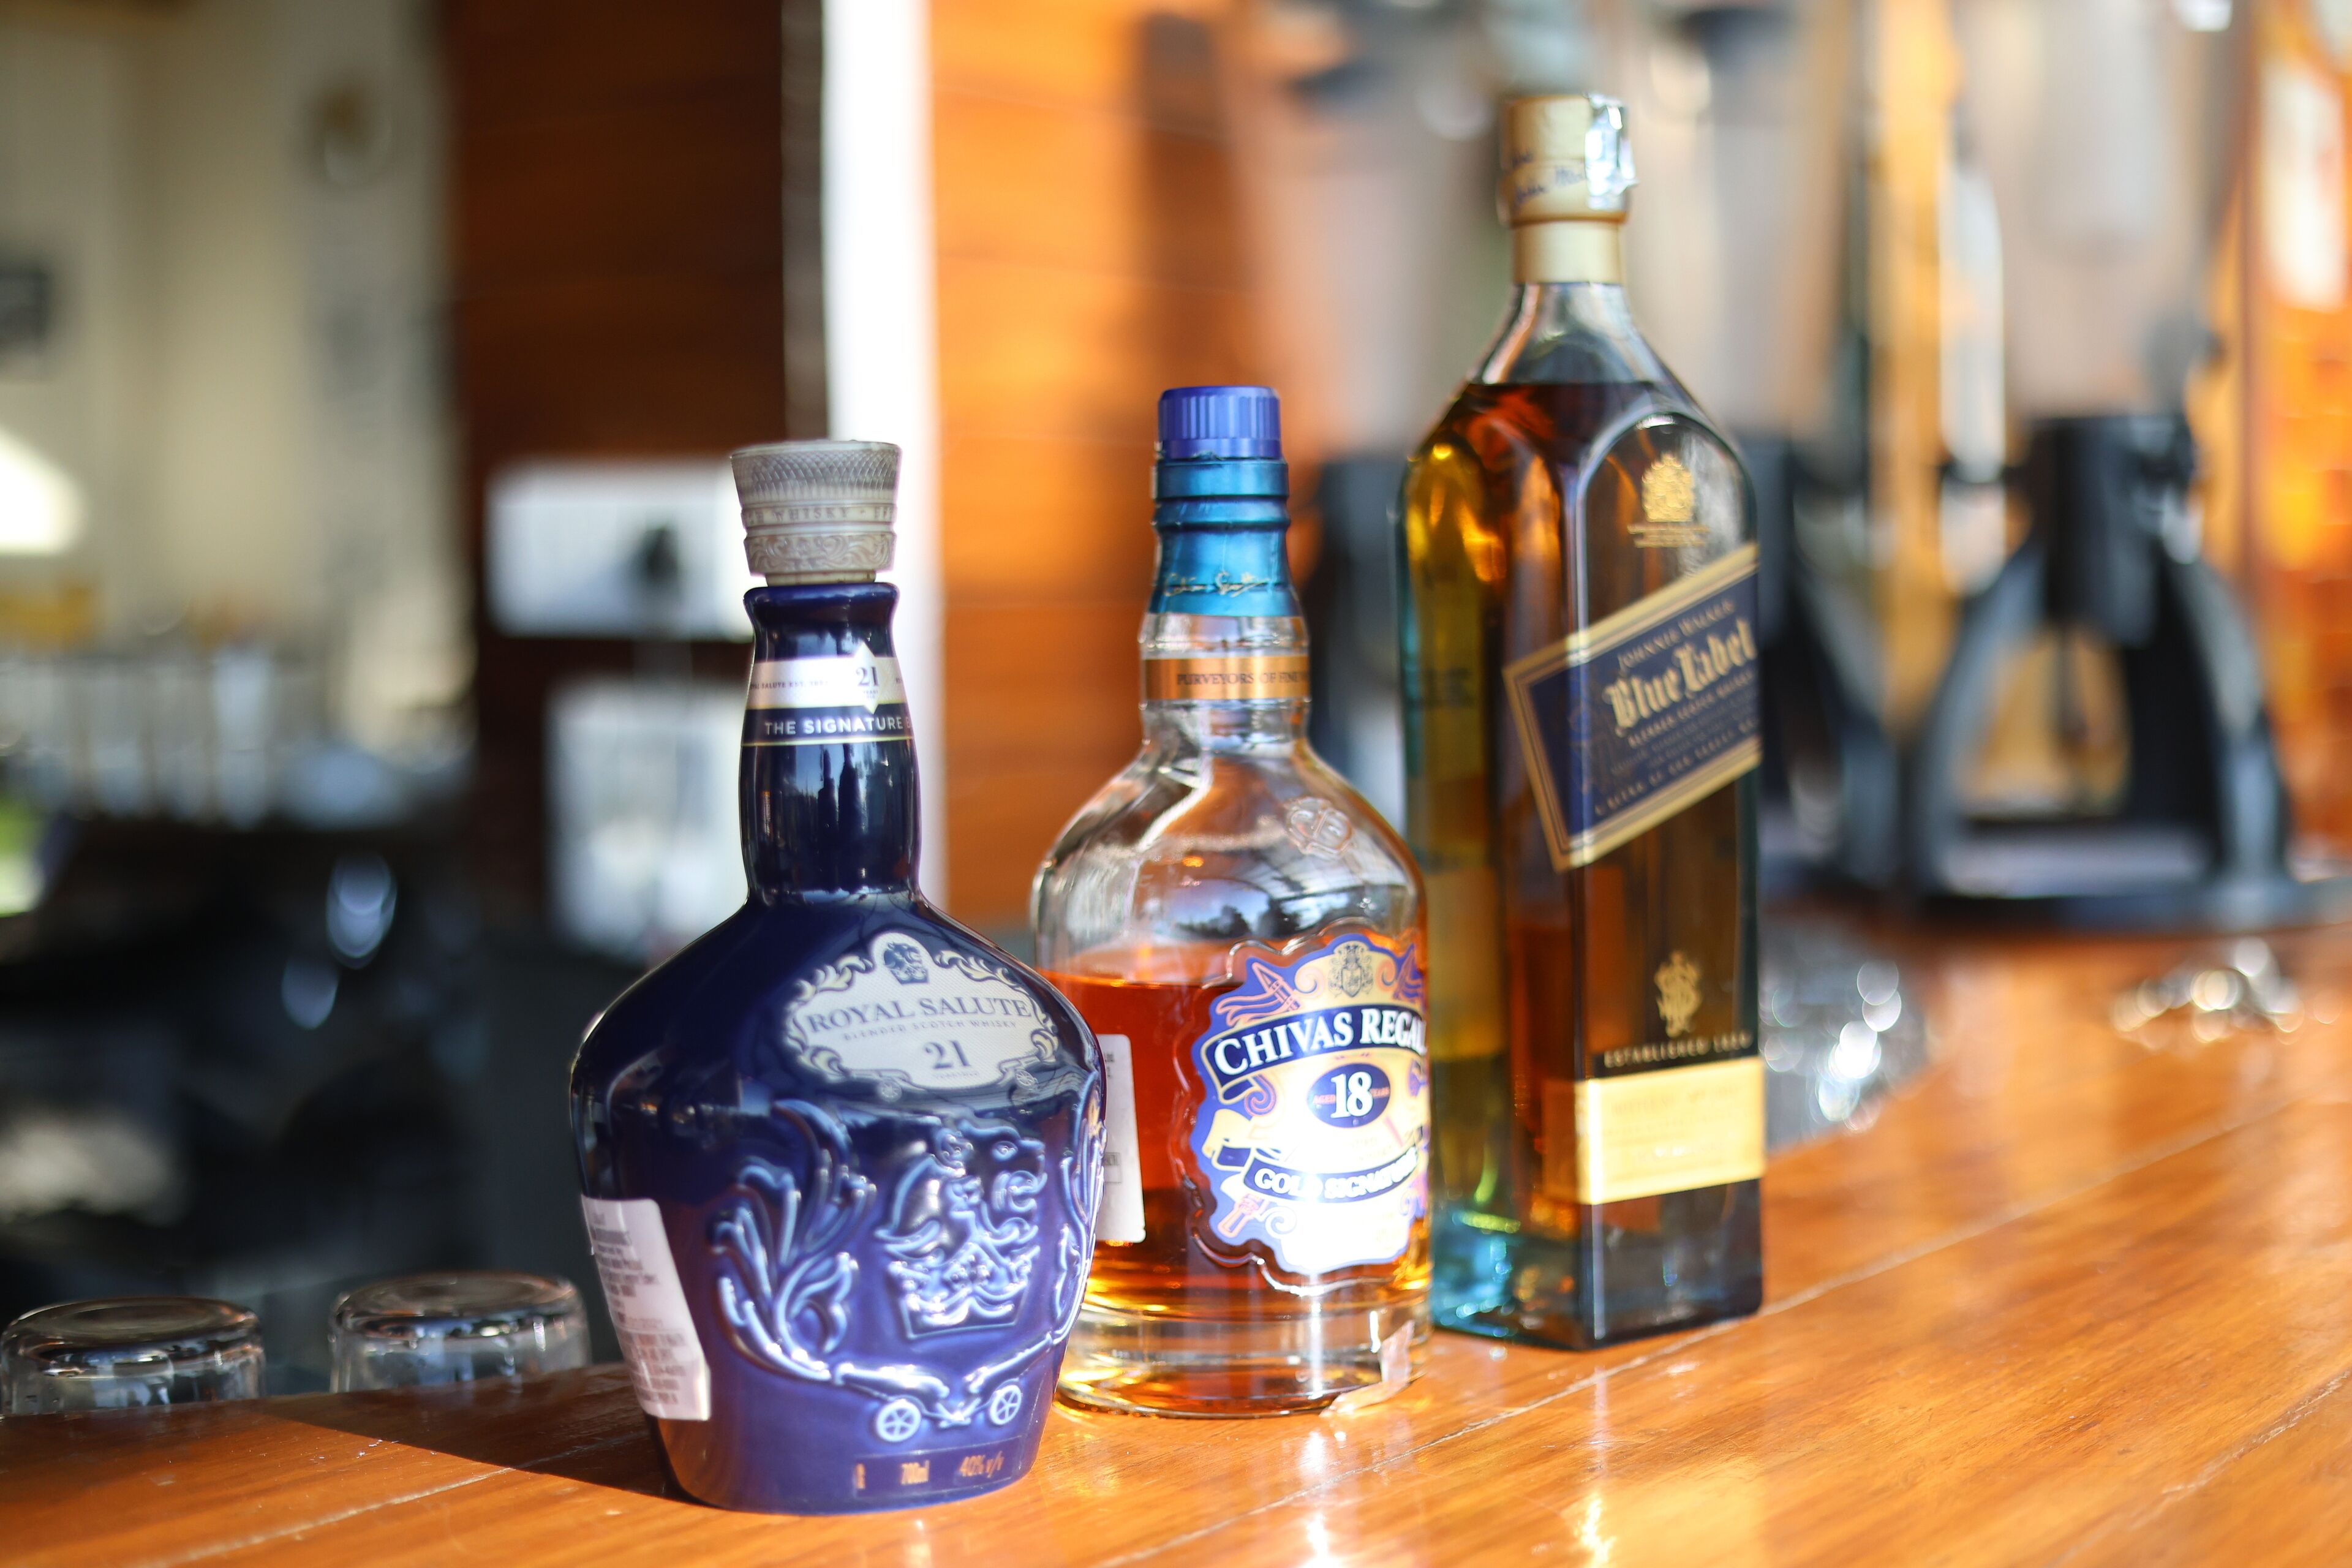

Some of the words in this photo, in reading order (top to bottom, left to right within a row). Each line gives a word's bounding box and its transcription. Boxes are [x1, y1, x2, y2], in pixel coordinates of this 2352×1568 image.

[774, 507, 849, 521] WHISKY
[856, 666, 878, 687] 21
[1177, 673, 1254, 685] PURVEYORS
[1259, 672, 1277, 684] OF
[1602, 667, 1683, 737] Blue
[1672, 617, 1757, 699] Label
[766, 720, 796, 736] THE
[803, 716, 903, 734] SIGNATURE
[807, 1000, 915, 1033] ROYAL
[921, 997, 1031, 1017] SALUTE
[844, 1024, 907, 1041] BLENDED
[913, 1020, 965, 1030] SCOTCH
[970, 1020, 1017, 1028] WHISKY
[924, 1040, 970, 1069] 21
[1214, 1011, 1354, 1077] CHIVAS
[1330, 1071, 1374, 1119] 18
